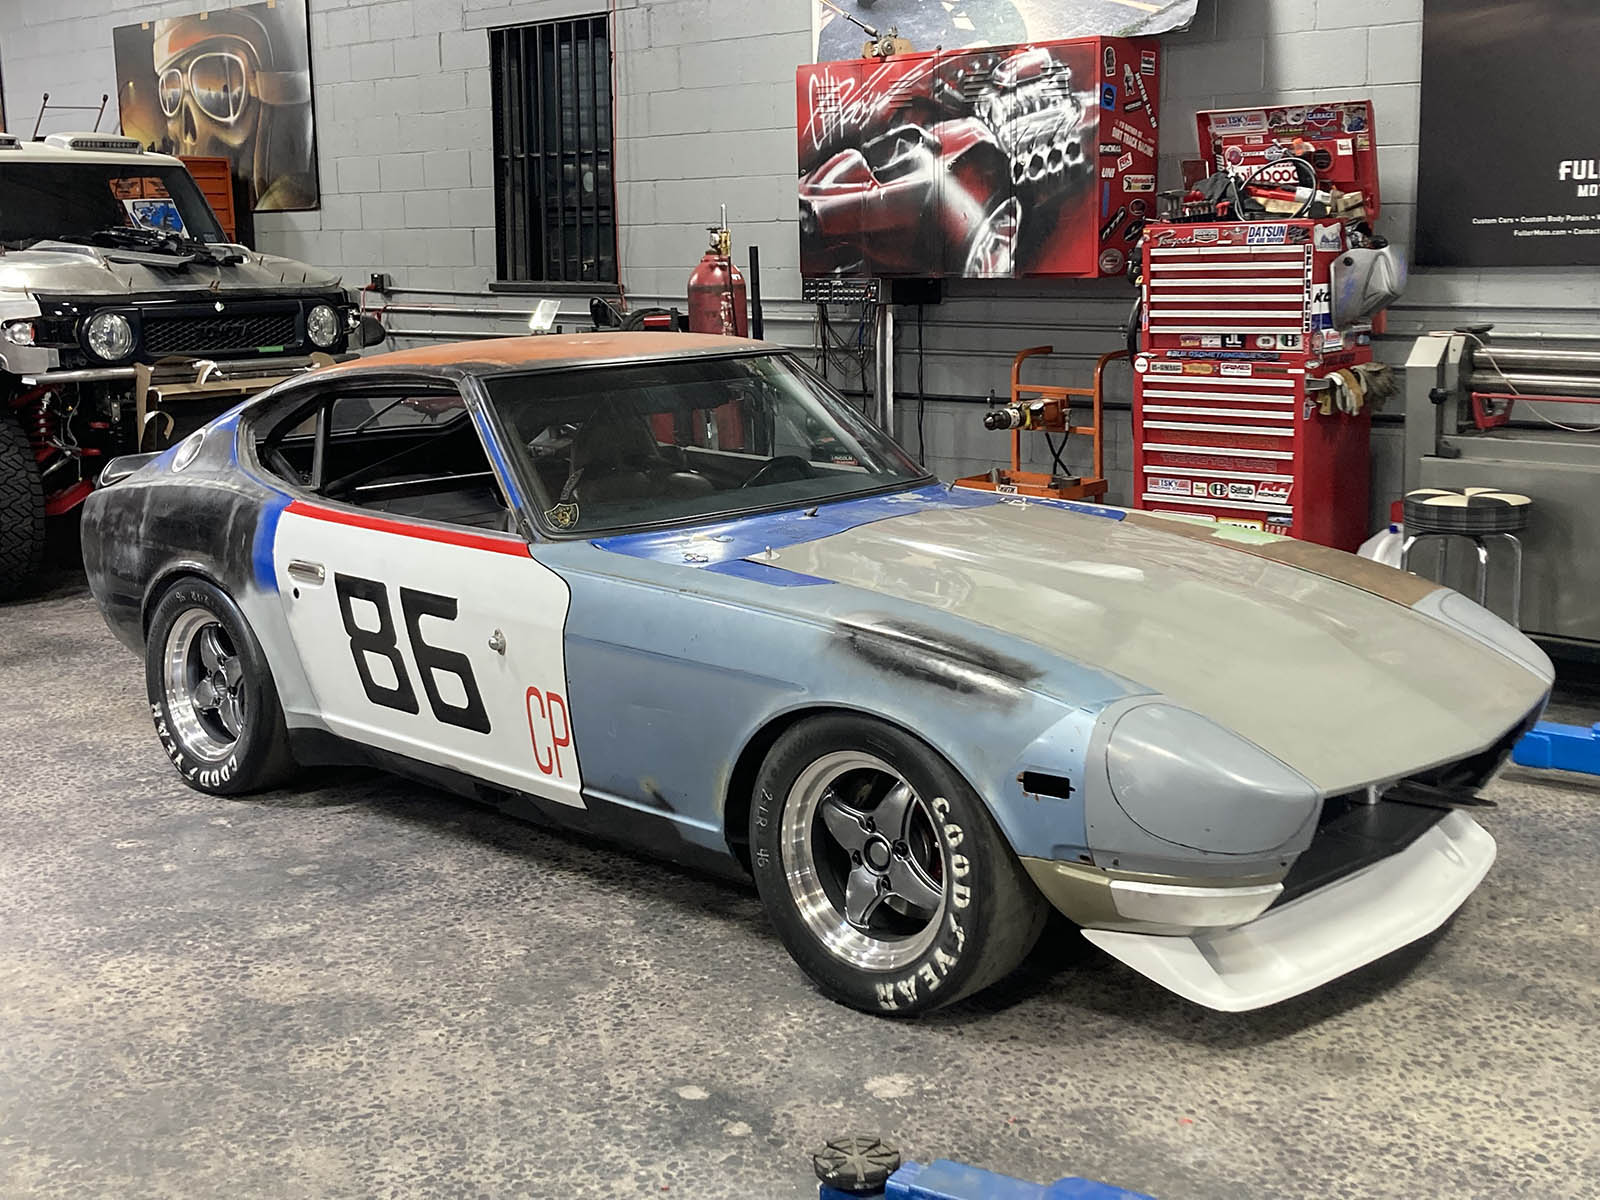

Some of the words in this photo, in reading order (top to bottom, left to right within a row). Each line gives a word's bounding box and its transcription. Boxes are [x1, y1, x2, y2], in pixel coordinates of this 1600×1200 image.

[1307, 111, 1336, 121] GARAGE
[1559, 159, 1600, 181] FUL
[1577, 183, 1600, 197] MO
[1498, 216, 1514, 224] Cars
[1520, 215, 1546, 223] Custom
[1547, 214, 1565, 223] Body
[1565, 214, 1590, 222] Panels
[1249, 225, 1286, 238] DATSUN
[1160, 479, 1178, 487] ISKY
[334, 571, 492, 736] 86
[525, 686, 571, 779] CP
[150, 701, 238, 788] GOODYEAR
[875, 796, 973, 1011] GOODYEAR
